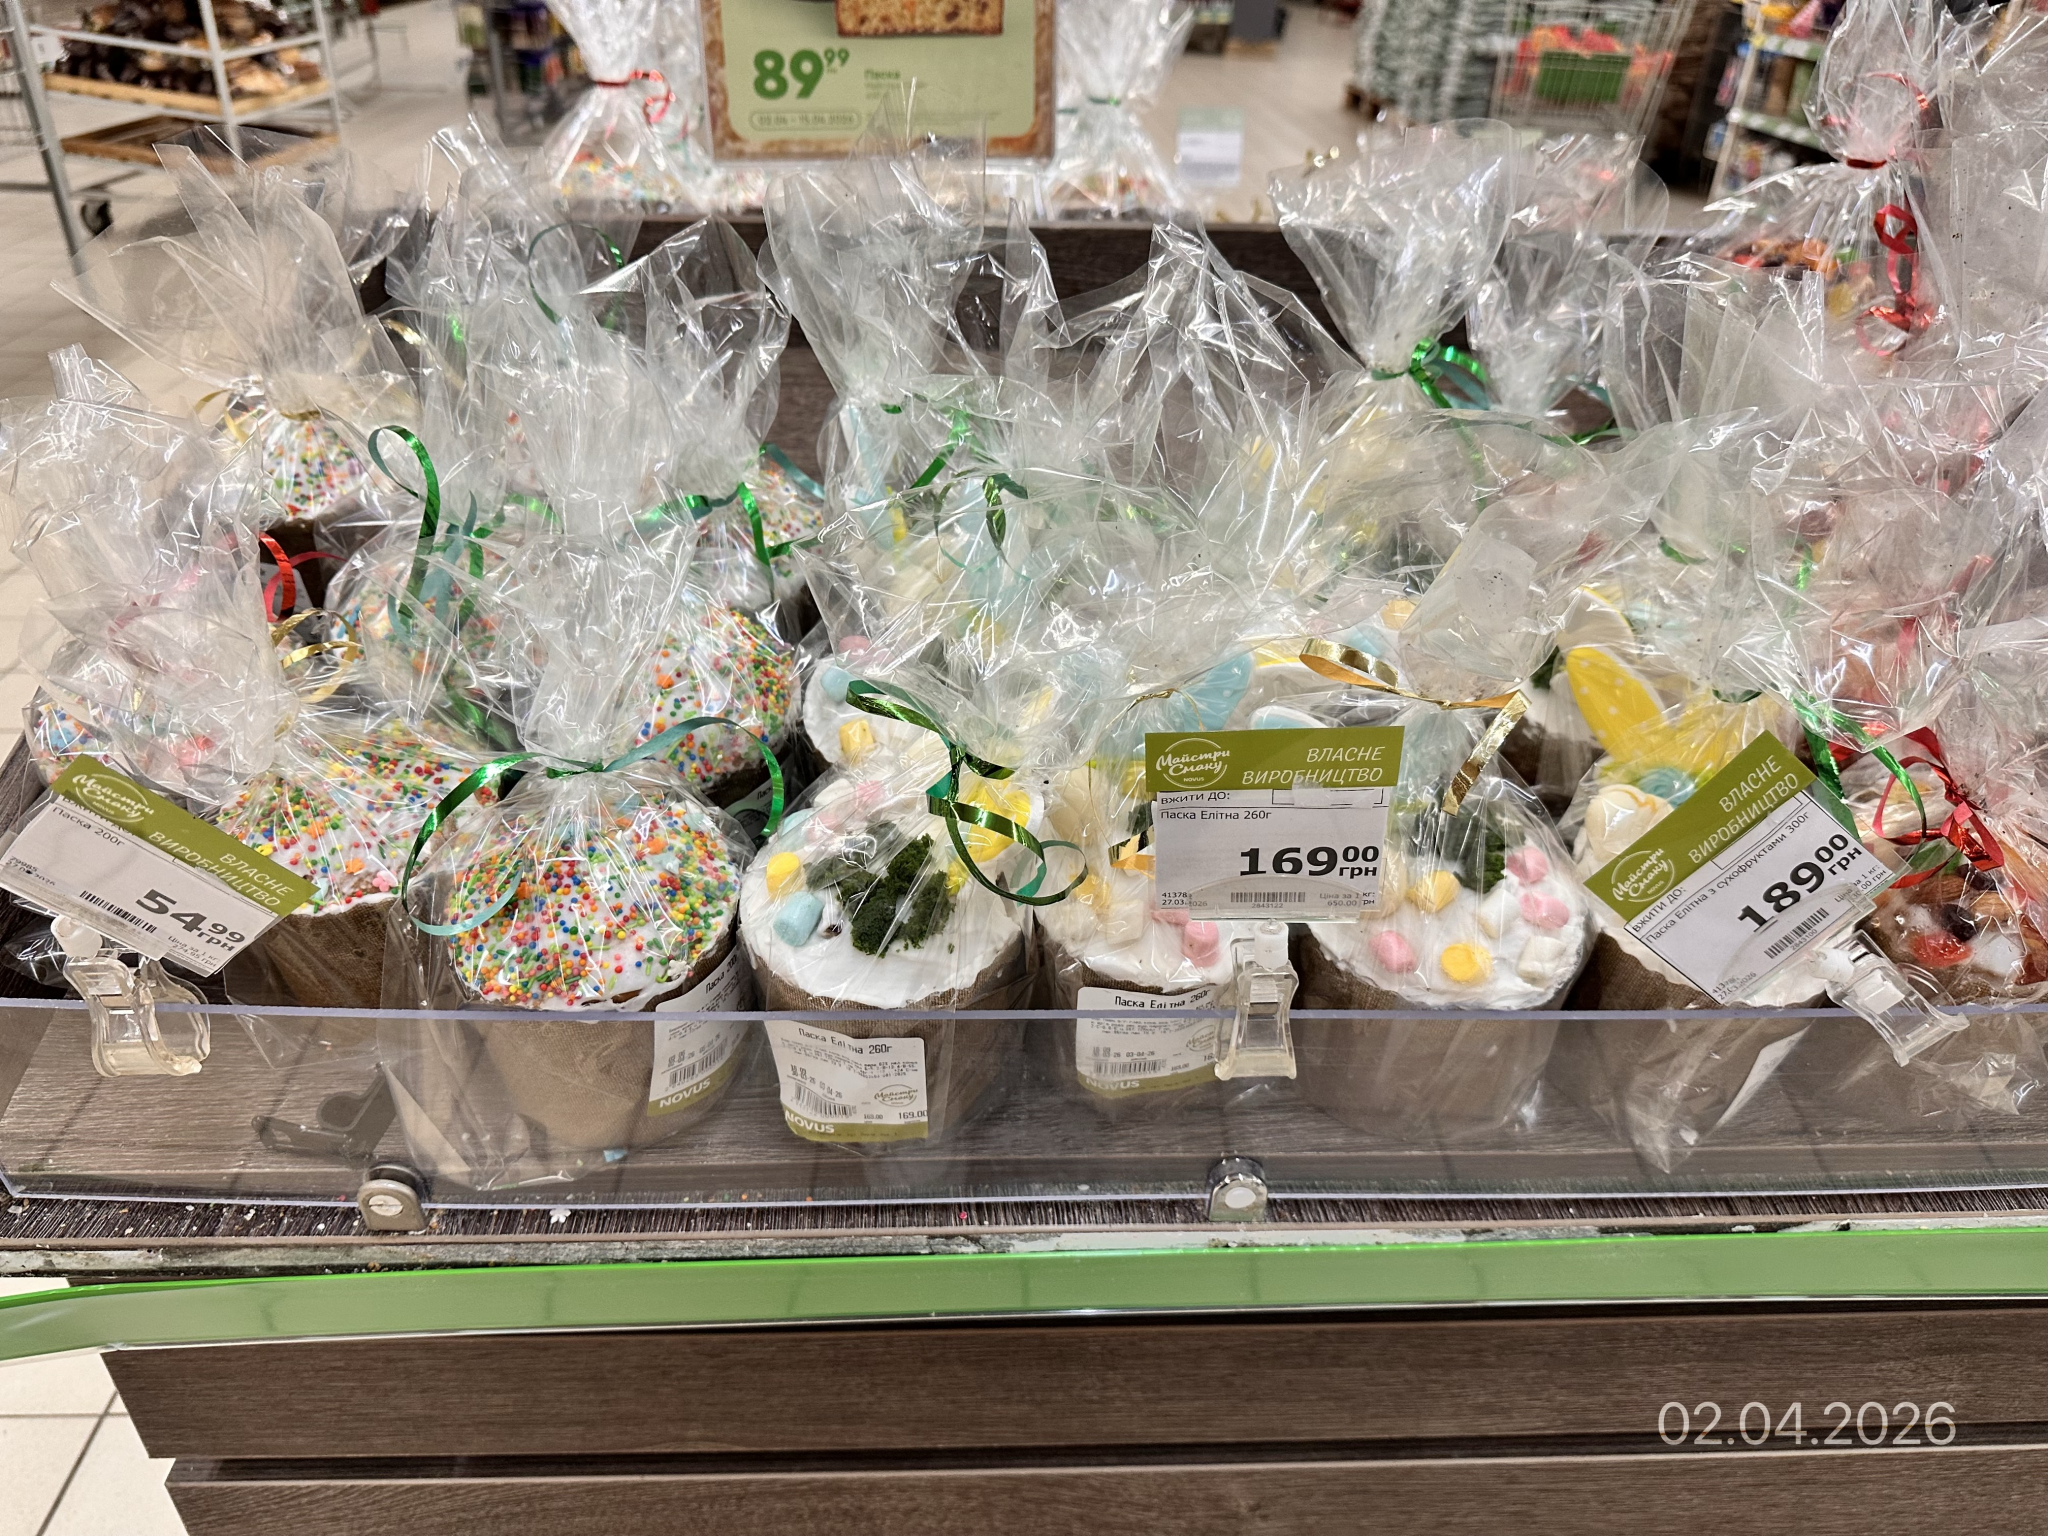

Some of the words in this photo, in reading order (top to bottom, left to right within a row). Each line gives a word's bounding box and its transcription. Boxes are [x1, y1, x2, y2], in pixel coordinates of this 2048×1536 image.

[753, 49, 824, 100] 89
[824, 48, 849, 67] 99
[1155, 750, 1231, 771] Майстри
[1168, 760, 1223, 776] Смаку
[1307, 746, 1386, 763] ВЛАСНЕ
[1242, 767, 1383, 785] ВИРОБНИЦТВО
[1719, 755, 1782, 813] ВЛАСНЕ
[72, 774, 155, 815] Майстри
[82, 787, 142, 818] Смаку
[1208, 791, 1230, 801] ДО:
[53, 806, 92, 830] Паска
[94, 827, 125, 846] 200г
[1161, 811, 1196, 820] Паска
[1201, 809, 1239, 820] Елітна
[1244, 810, 1272, 820] 260г
[1689, 773, 1799, 864] ВИРОБНИЦТВО
[148, 831, 280, 907] ВИРОБНИЦТВО
[219, 853, 294, 896] ВЛАСНЕ
[1240, 846, 1338, 877] 169
[1342, 845, 1379, 863] 00
[1339, 866, 1377, 879] грн
[1612, 848, 1664, 901] Майстри
[1827, 847, 1862, 876] грн
[1629, 860, 1669, 897] Смаку
[1646, 917, 1677, 944] Паска
[1675, 893, 1709, 920] Елітна
[1709, 886, 1717, 895] з
[1716, 832, 1787, 892] сухофруктами
[1785, 811, 1811, 834] 300г
[1737, 861, 1825, 933] 189
[1814, 833, 1849, 863] 00
[1872, 870, 1887, 884] грн
[135, 888, 208, 933] 54
[208, 923, 246, 943] 99
[1632, 900, 1668, 933] ВЖИТИ
[1666, 886, 1688, 905] ДО:
[168, 935, 188, 949] Ціна
[197, 931, 236, 952] грн
[1791, 928, 1818, 951] 2843100
[200, 956, 217, 967] грн
[706, 971, 725, 994] Паска
[1115, 996, 1145, 1008] Паска
[1150, 999, 1185, 1009] Елітна
[1190, 989, 1211, 1003] 260г
[799, 1028, 827, 1043] Паска
[831, 1036, 864, 1055] Елітна
[869, 1044, 892, 1054] 260г
[660, 1078, 710, 1108] NOVUS
[1086, 1078, 1140, 1091] NOVUS
[784, 1109, 835, 1134] NOVUS
